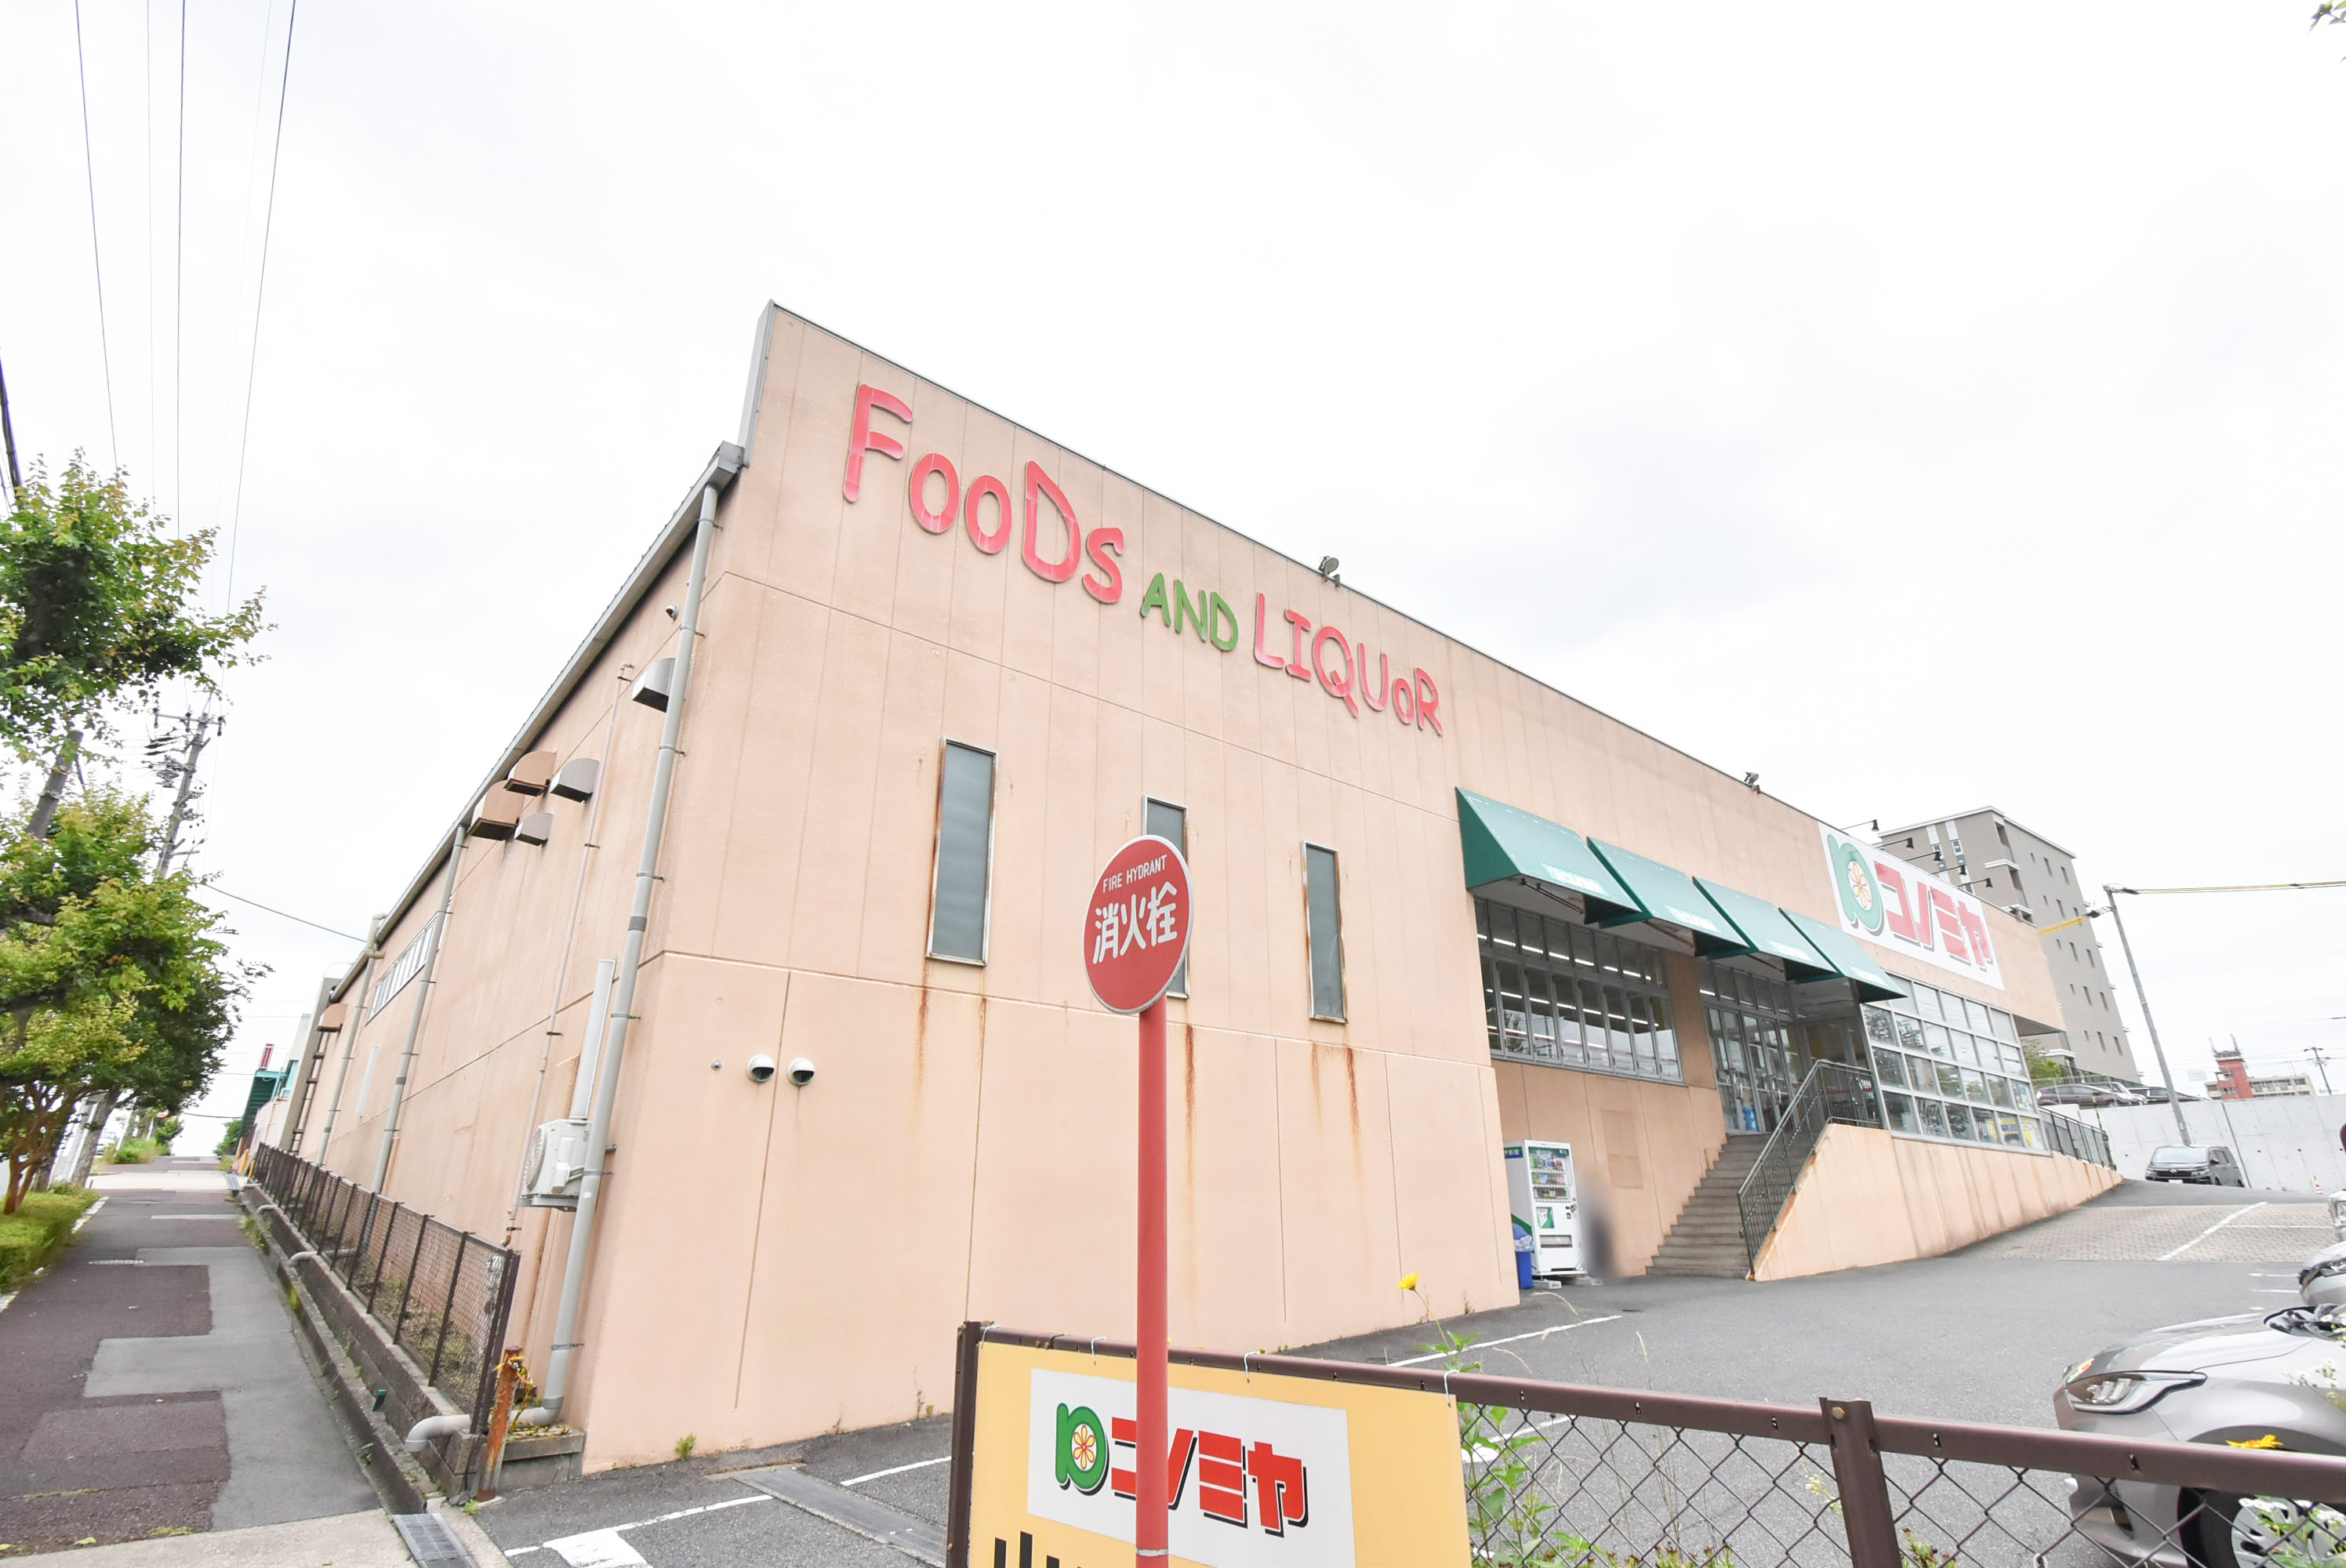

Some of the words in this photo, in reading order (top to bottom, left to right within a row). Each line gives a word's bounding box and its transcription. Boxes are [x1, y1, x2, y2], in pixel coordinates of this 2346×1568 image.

[1139, 572, 1239, 652] AND
[1102, 872, 1123, 893] FIRE
[1126, 855, 1168, 884] HYDRANT
[1092, 881, 1178, 964] 消火栓
[1873, 860, 1992, 971] コノミヤ
